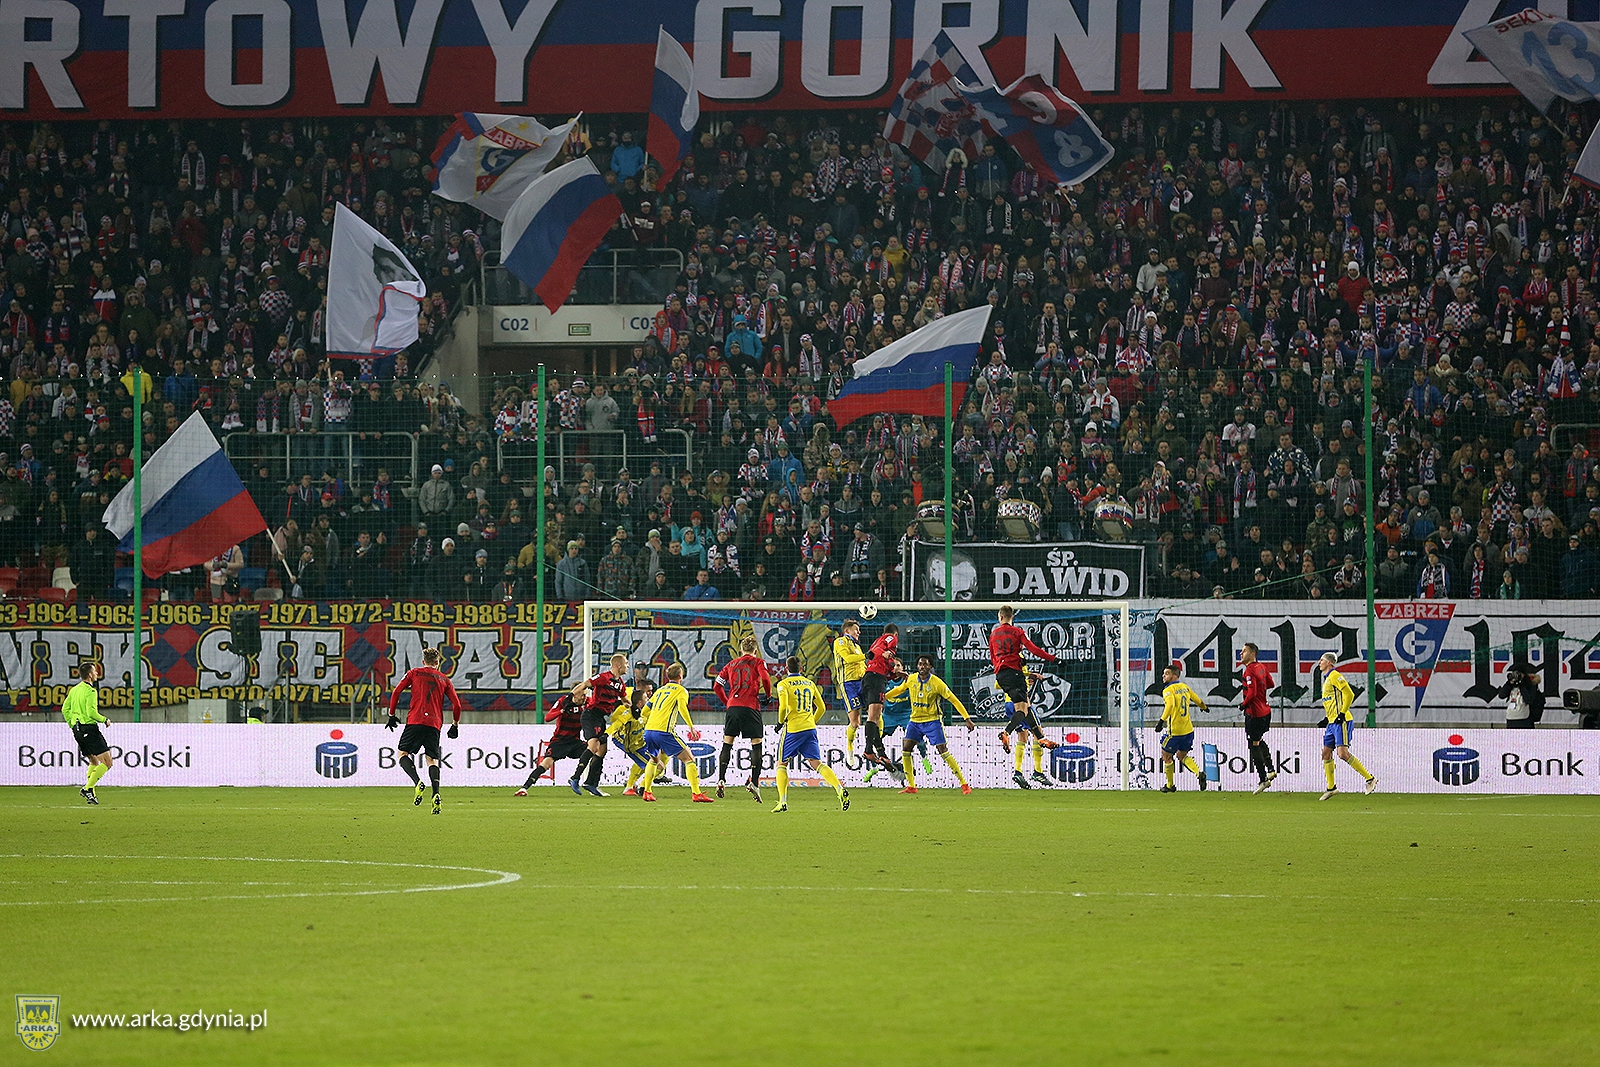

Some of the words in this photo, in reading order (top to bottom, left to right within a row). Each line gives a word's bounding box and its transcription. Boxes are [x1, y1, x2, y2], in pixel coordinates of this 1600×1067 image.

[500, 318, 529, 331] C02
[993, 567, 1129, 597] DAWID
[1381, 604, 1449, 618] ZABRZE
[937, 623, 1096, 648] PATOR
[427, 681, 437, 704] 7
[794, 688, 811, 712] 10
[851, 697, 861, 708] 33
[1181, 696, 1187, 717] 9
[1501, 752, 1584, 776] Bank
